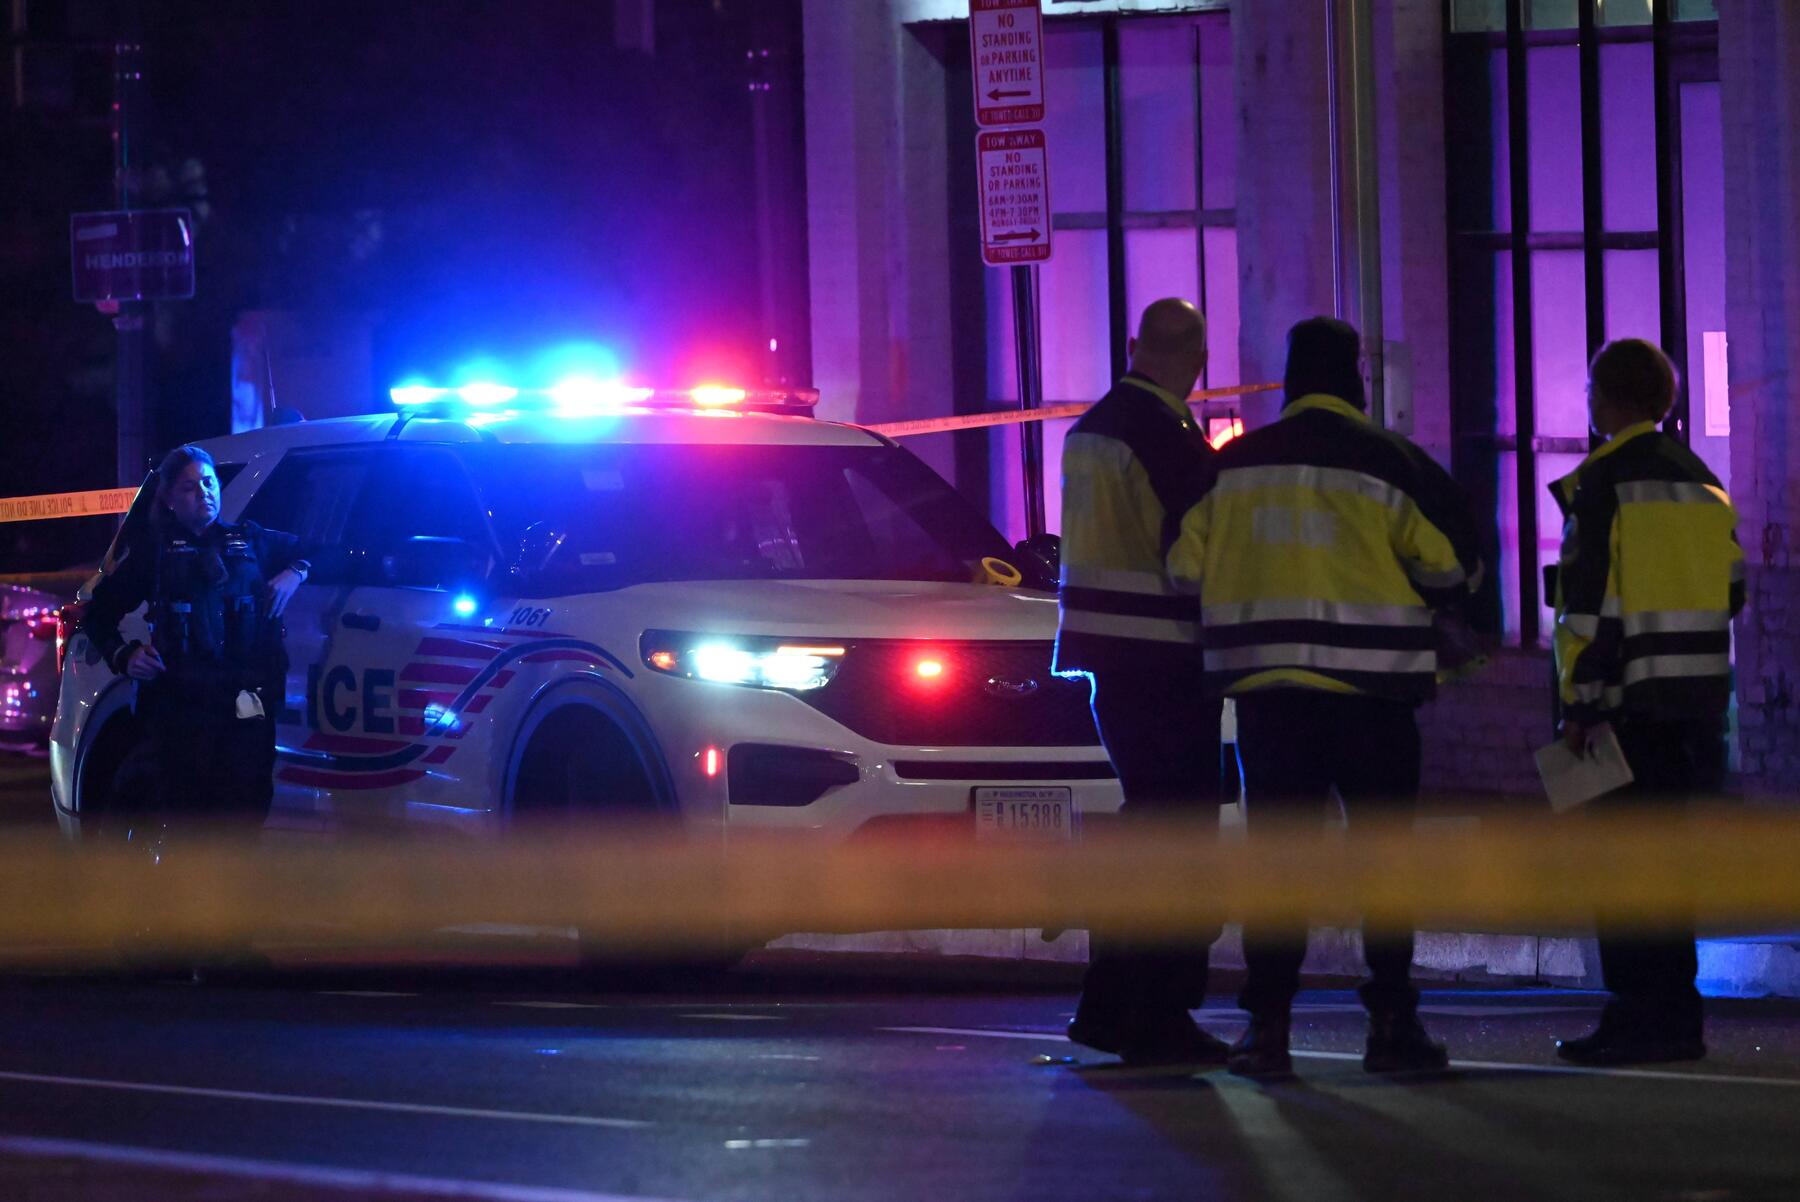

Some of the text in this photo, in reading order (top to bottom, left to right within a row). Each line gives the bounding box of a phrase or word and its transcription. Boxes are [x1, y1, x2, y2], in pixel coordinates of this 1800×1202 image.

[998, 13, 1015, 28] NO
[982, 31, 1032, 48] STANDING
[991, 49, 1036, 65] PARKING
[989, 67, 1032, 83] ANYTIME
[986, 134, 1035, 148] TOW AWAY
[1005, 152, 1021, 163] NO
[990, 163, 1038, 177] STANDING
[988, 178, 1041, 192] OR PARKING
[507, 606, 550, 628] 1061
[277, 663, 396, 734] LICE
